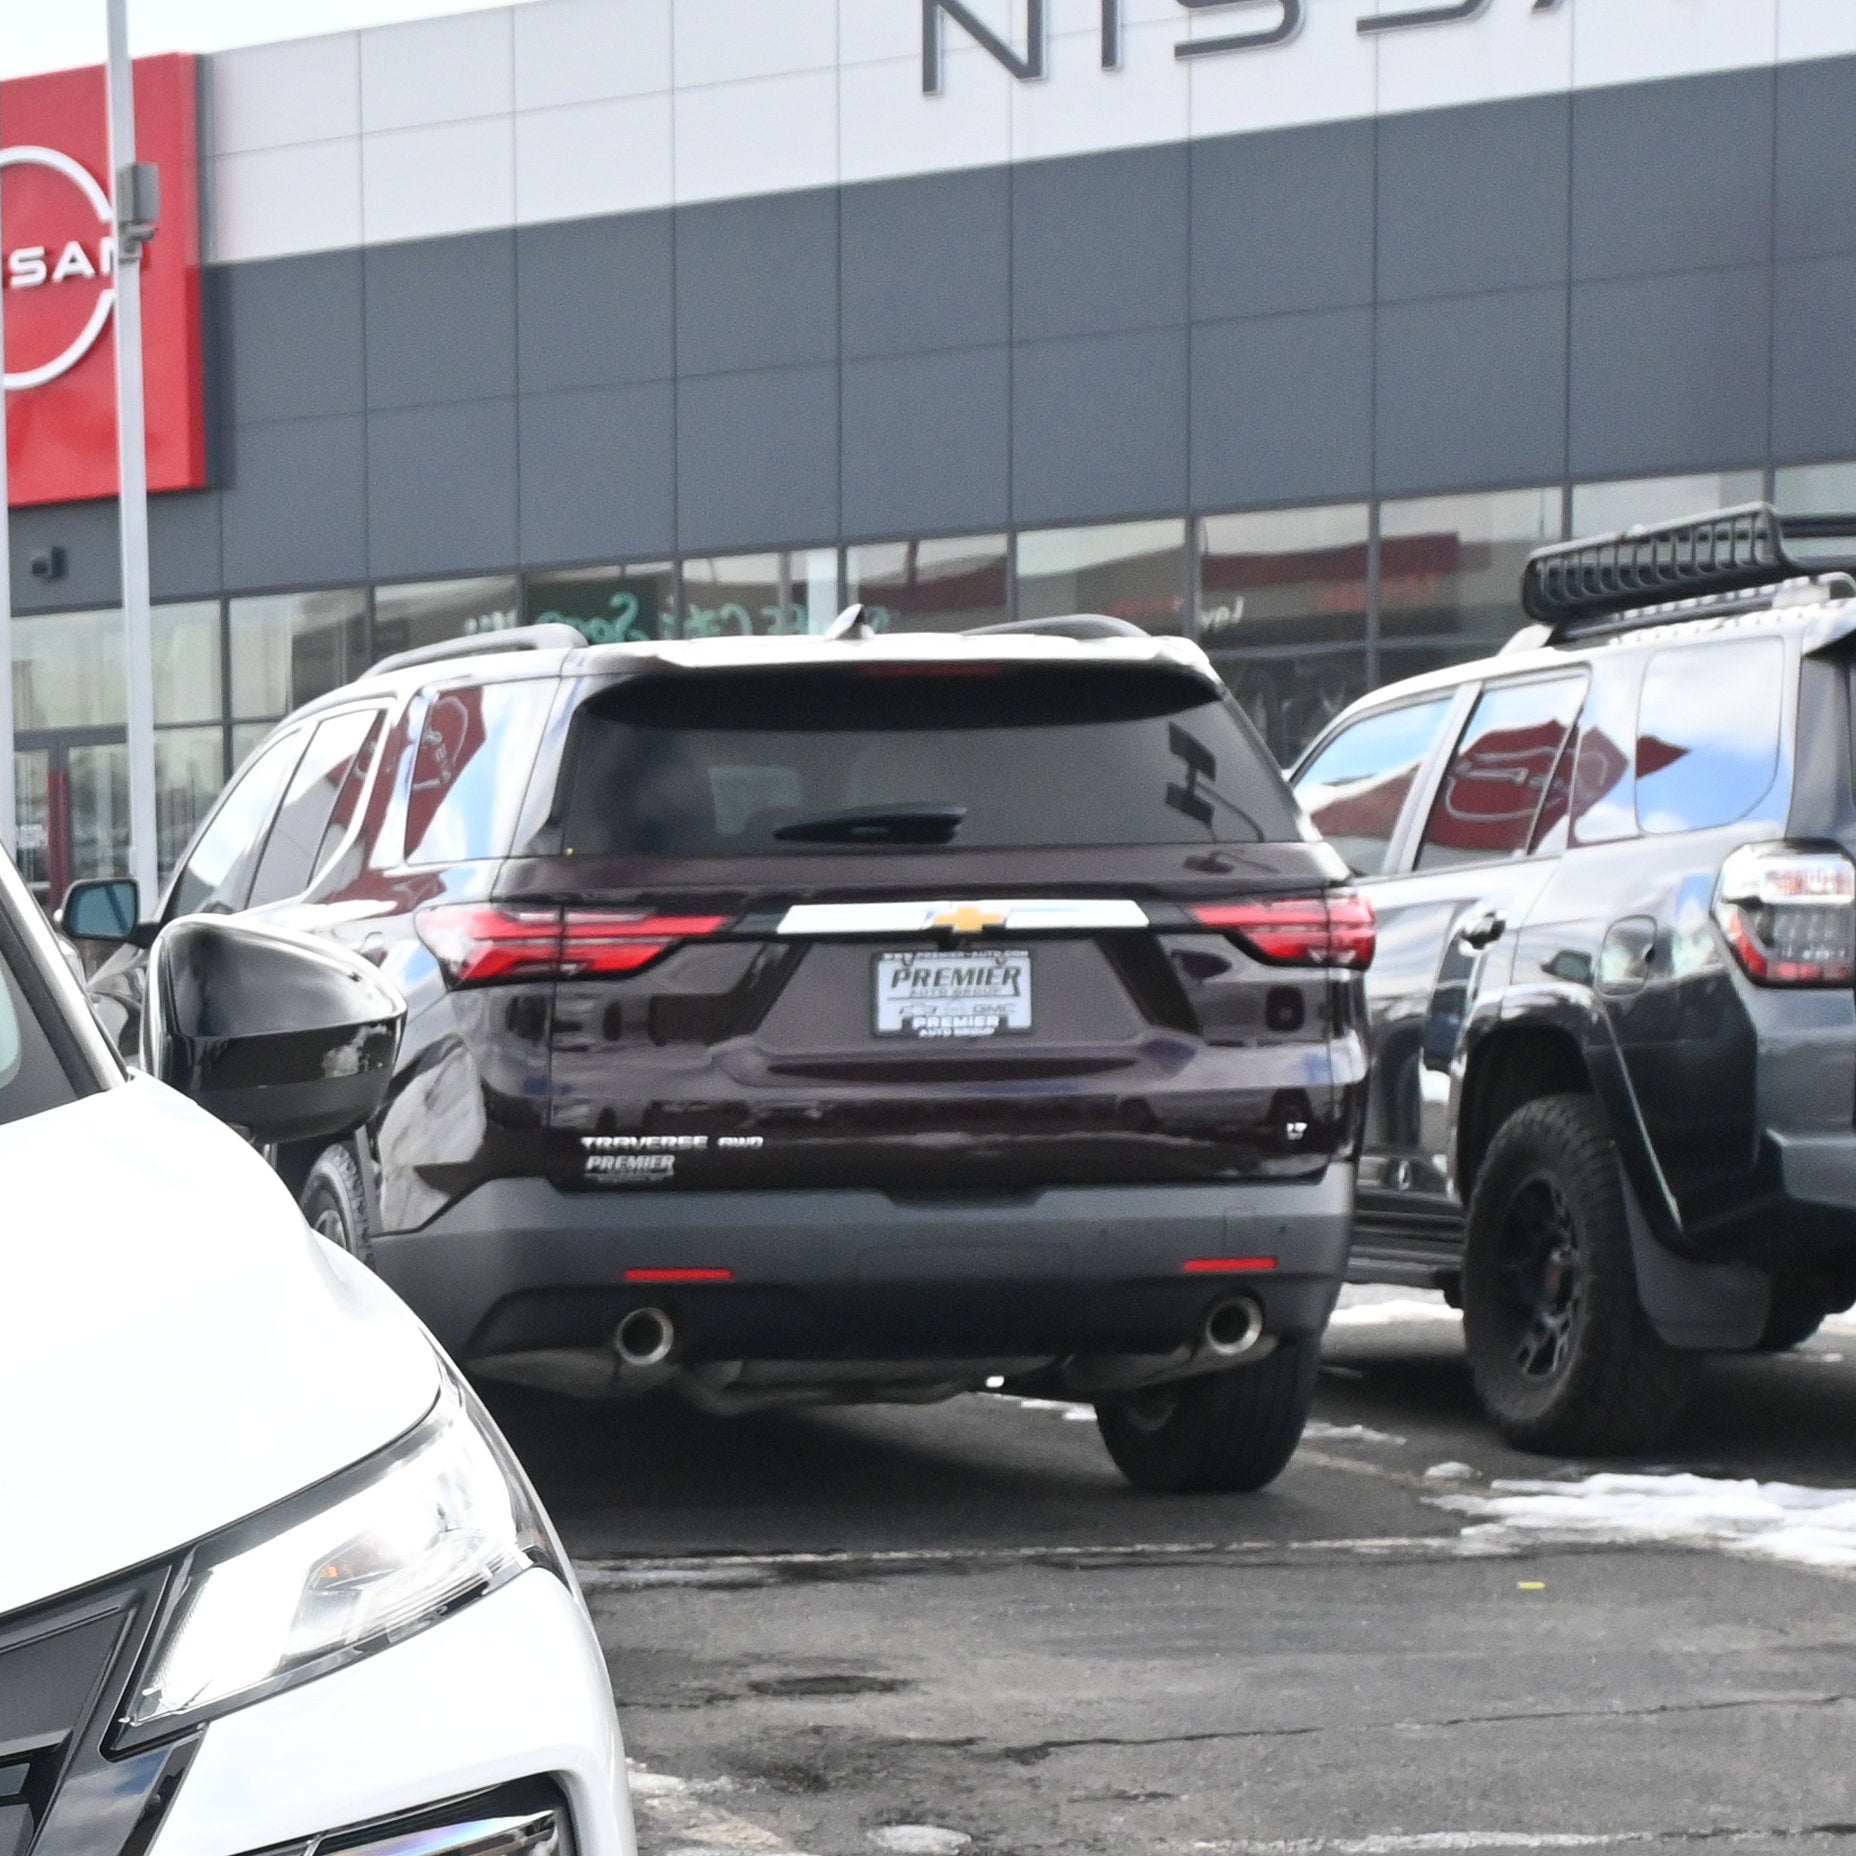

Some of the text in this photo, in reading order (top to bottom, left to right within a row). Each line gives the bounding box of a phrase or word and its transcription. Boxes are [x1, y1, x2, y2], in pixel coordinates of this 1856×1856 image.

[891, 967, 1021, 997] PREMIER
[912, 1016, 1000, 1028] PREMIER
[586, 1155, 676, 1175] PREMIER
